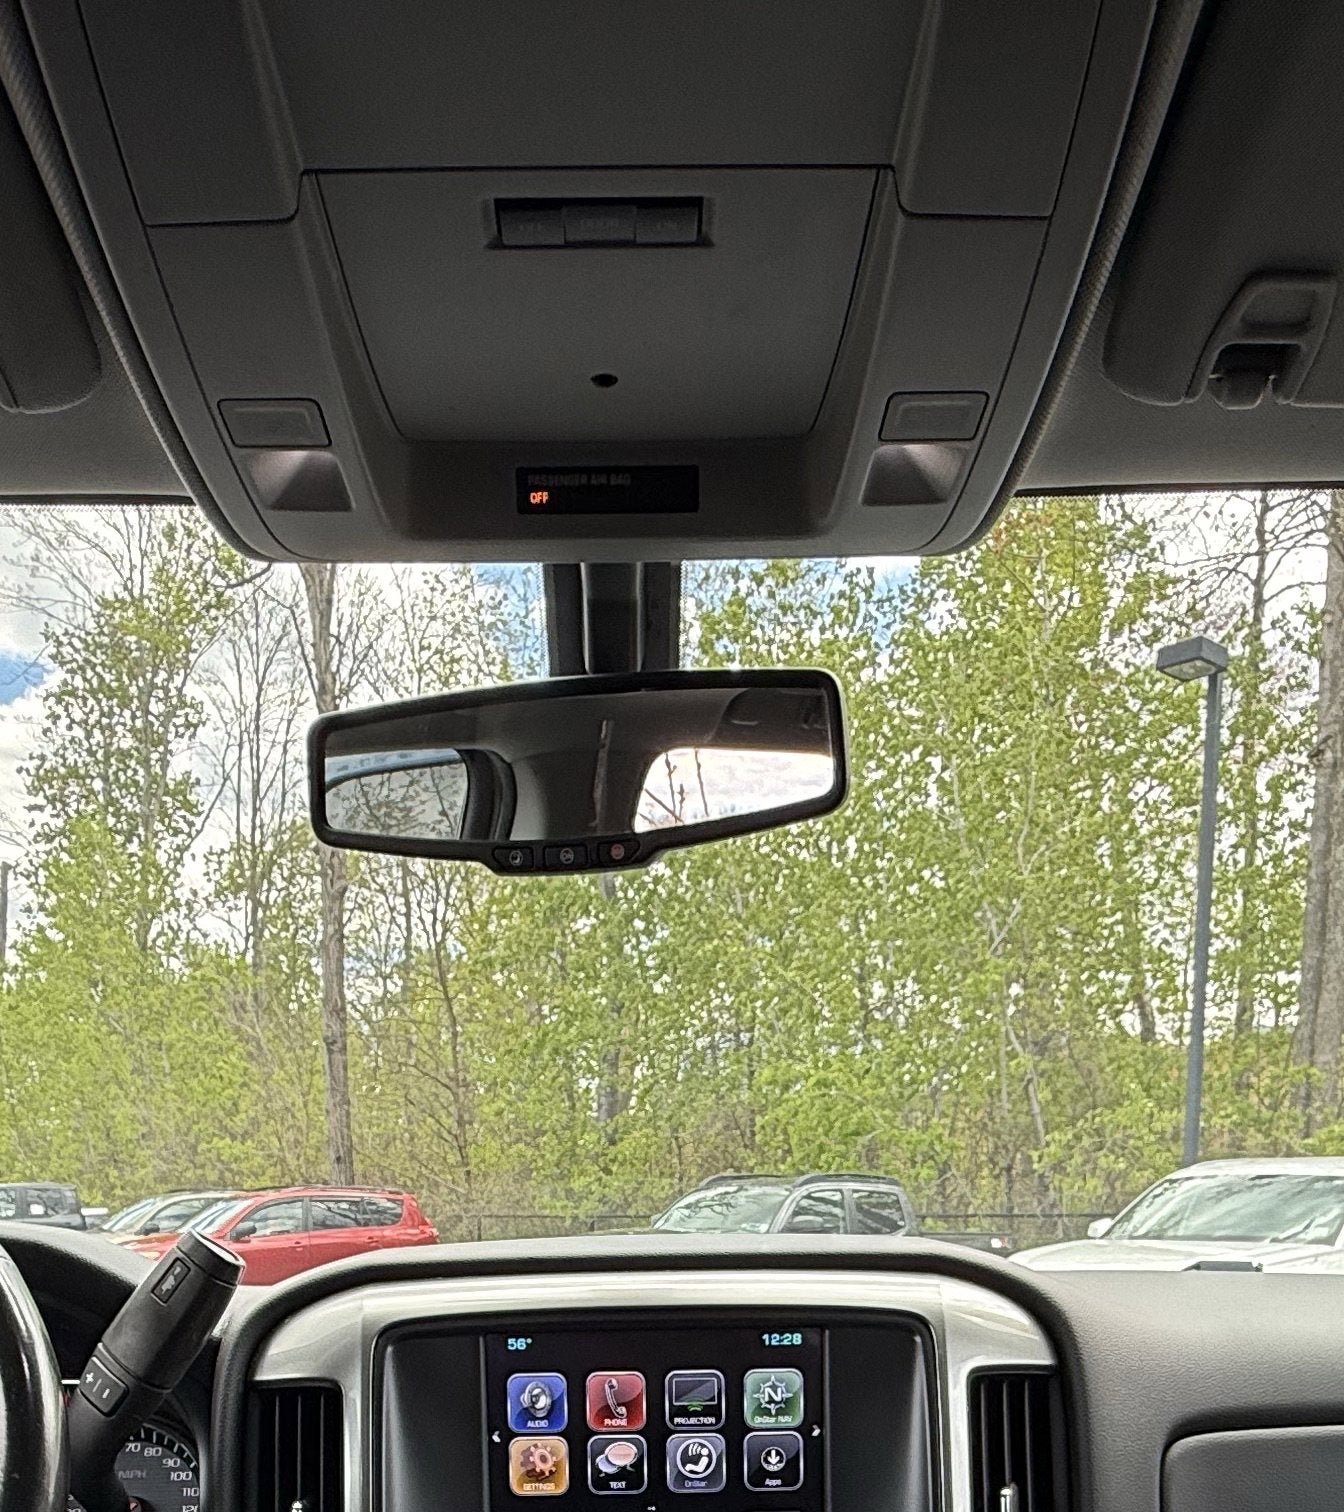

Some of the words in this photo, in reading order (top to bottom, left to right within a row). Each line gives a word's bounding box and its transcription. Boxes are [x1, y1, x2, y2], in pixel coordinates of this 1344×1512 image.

[529, 491, 549, 504] OFF
[507, 1337, 533, 1351] 56°
[761, 1332, 803, 1346] 12:28
[526, 1420, 549, 1429] AUDIO
[604, 1418, 628, 1427] PHONE
[673, 1416, 716, 1425] PROJECTION
[125, 1442, 141, 1453] 70
[143, 1446, 162, 1457] 80
[162, 1457, 181, 1468] 90
[118, 1469, 147, 1479] MPH
[170, 1470, 193, 1482] 100
[609, 1481, 627, 1489] TEXT
[684, 1479, 708, 1488] OnStar
[764, 1478, 782, 1487] Apps
[182, 1487, 199, 1497] 110
